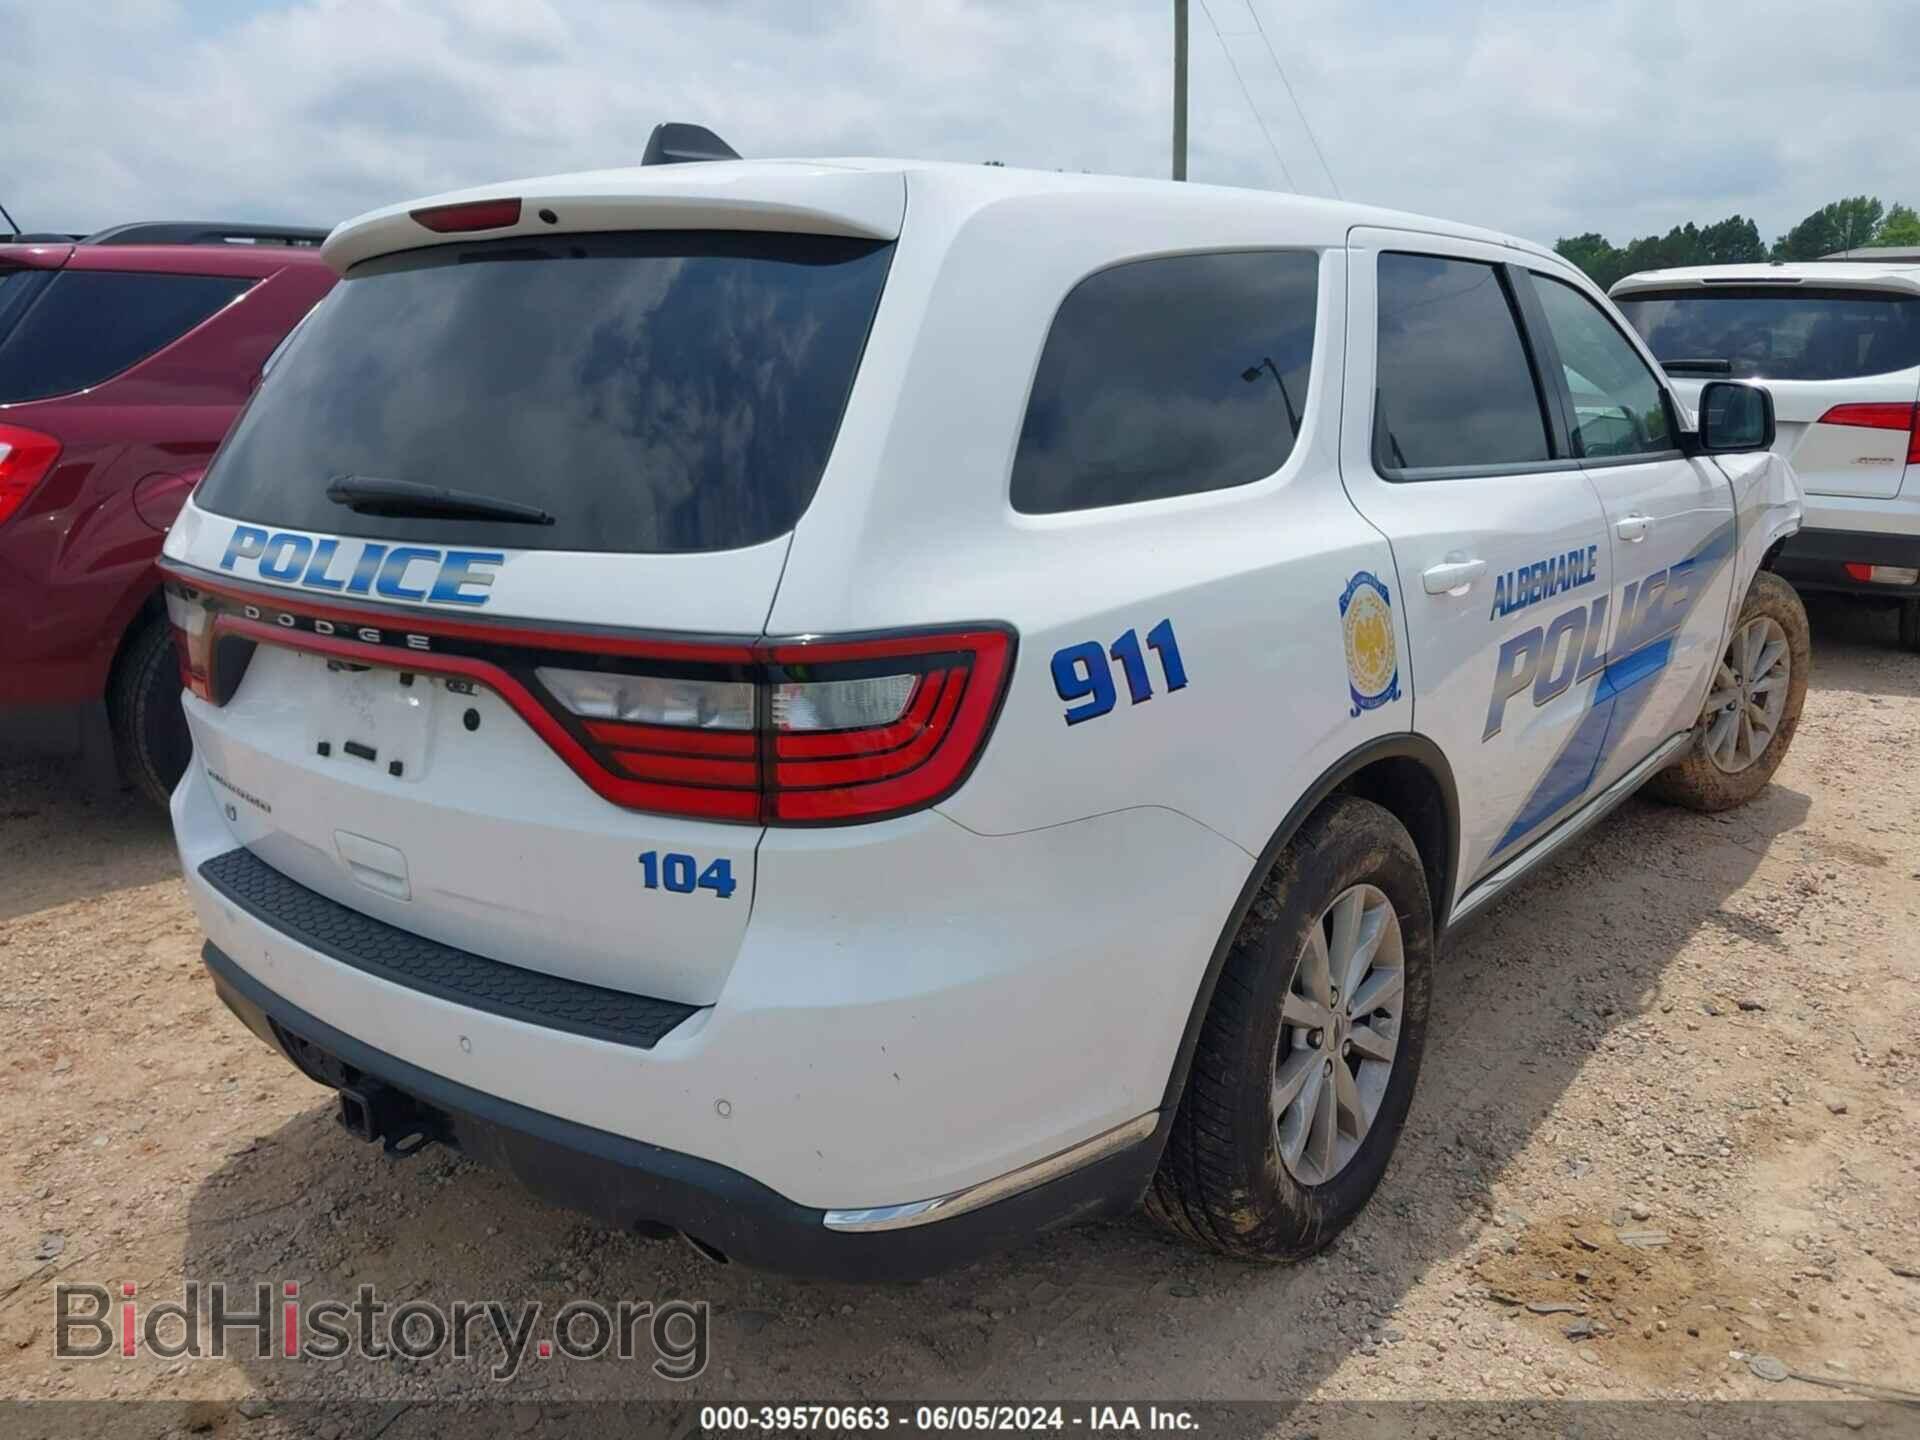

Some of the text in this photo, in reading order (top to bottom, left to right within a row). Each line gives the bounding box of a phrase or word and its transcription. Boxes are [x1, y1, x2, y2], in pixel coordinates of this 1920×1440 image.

[219, 525, 505, 606] POLICE
[1490, 544, 1598, 621] ALBEMARLE
[245, 605, 431, 650] DODGE
[1482, 557, 1698, 744] POLICE
[1050, 618, 1188, 727] 911
[638, 851, 737, 899] 104
